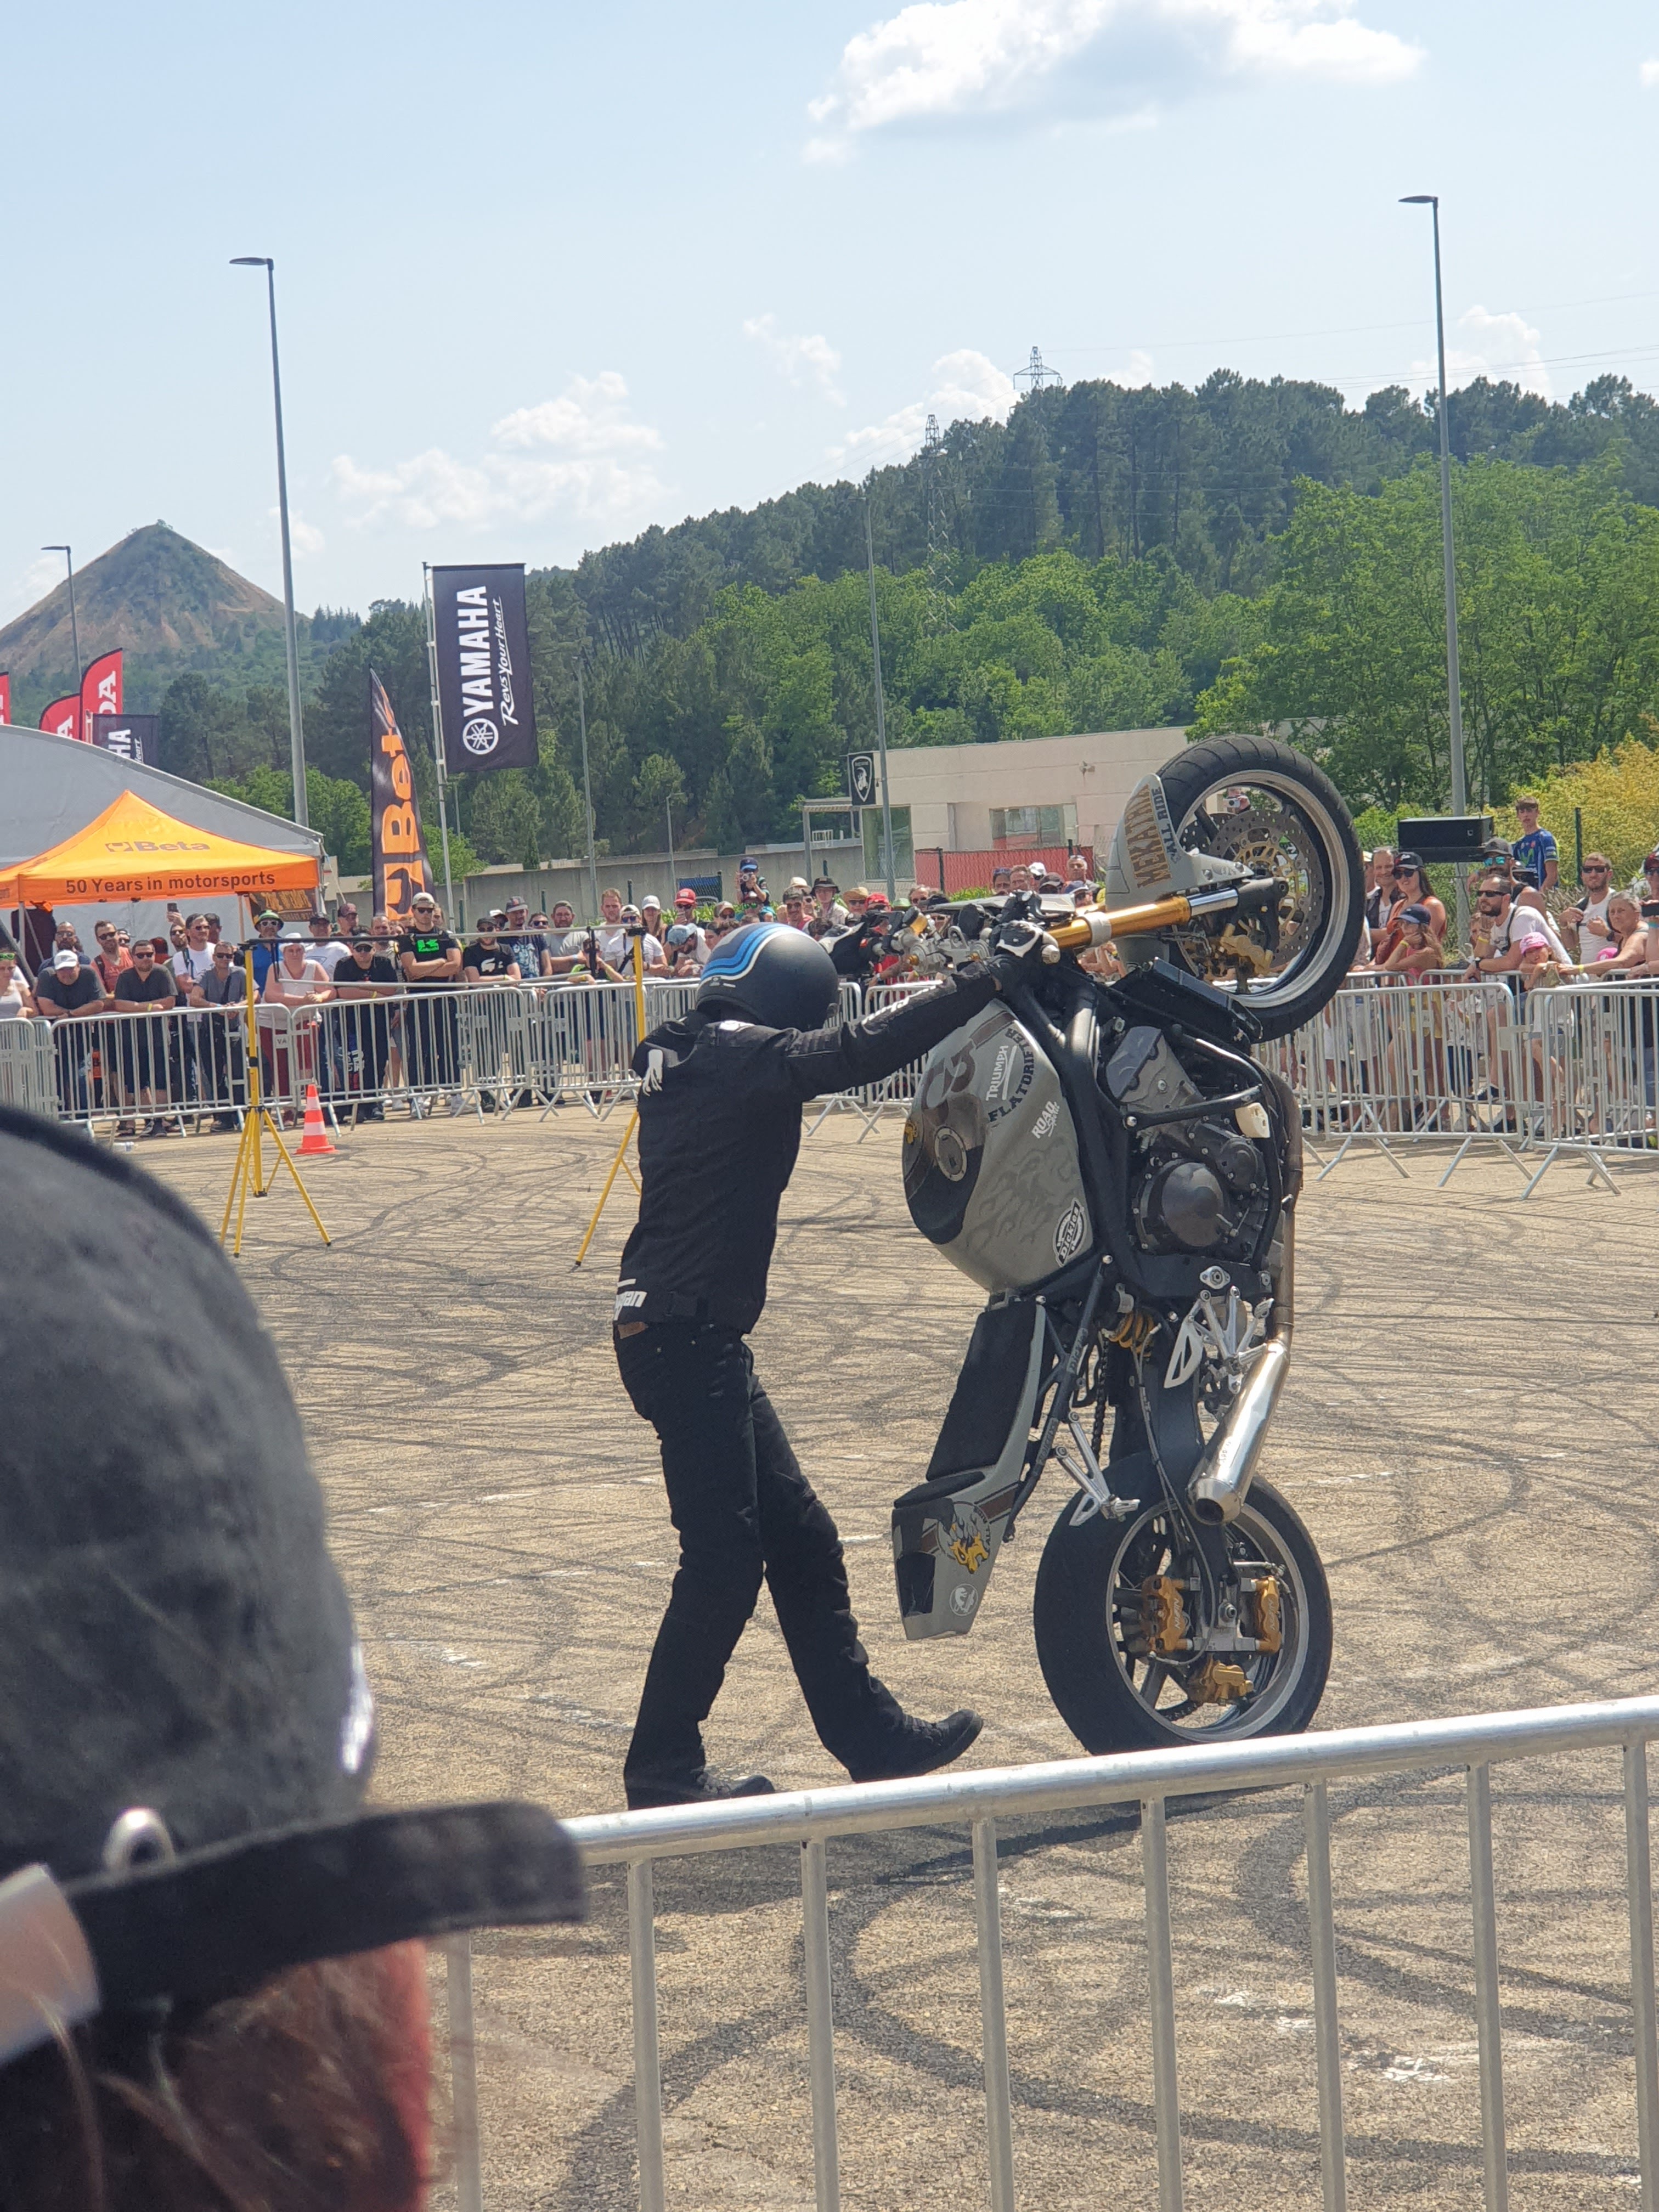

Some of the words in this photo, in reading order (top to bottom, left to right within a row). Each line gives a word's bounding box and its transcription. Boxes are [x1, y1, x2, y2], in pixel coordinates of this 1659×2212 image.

[493, 596, 505, 638] Heart
[457, 585, 494, 717] YAMAHA
[498, 637, 513, 676] Your
[500, 676, 518, 726] Revs
[1152, 787, 1169, 820] RIDE
[134, 841, 210, 851] Beta
[66, 879, 87, 894] 50
[92, 878, 143, 893] Years
[148, 876, 162, 890] in
[169, 871, 275, 889] motorsports
[986, 1045, 1009, 1101] TRIUMPH
[1032, 1101, 1056, 1139] ROAD
[1059, 1206, 1079, 1259] Dickies
